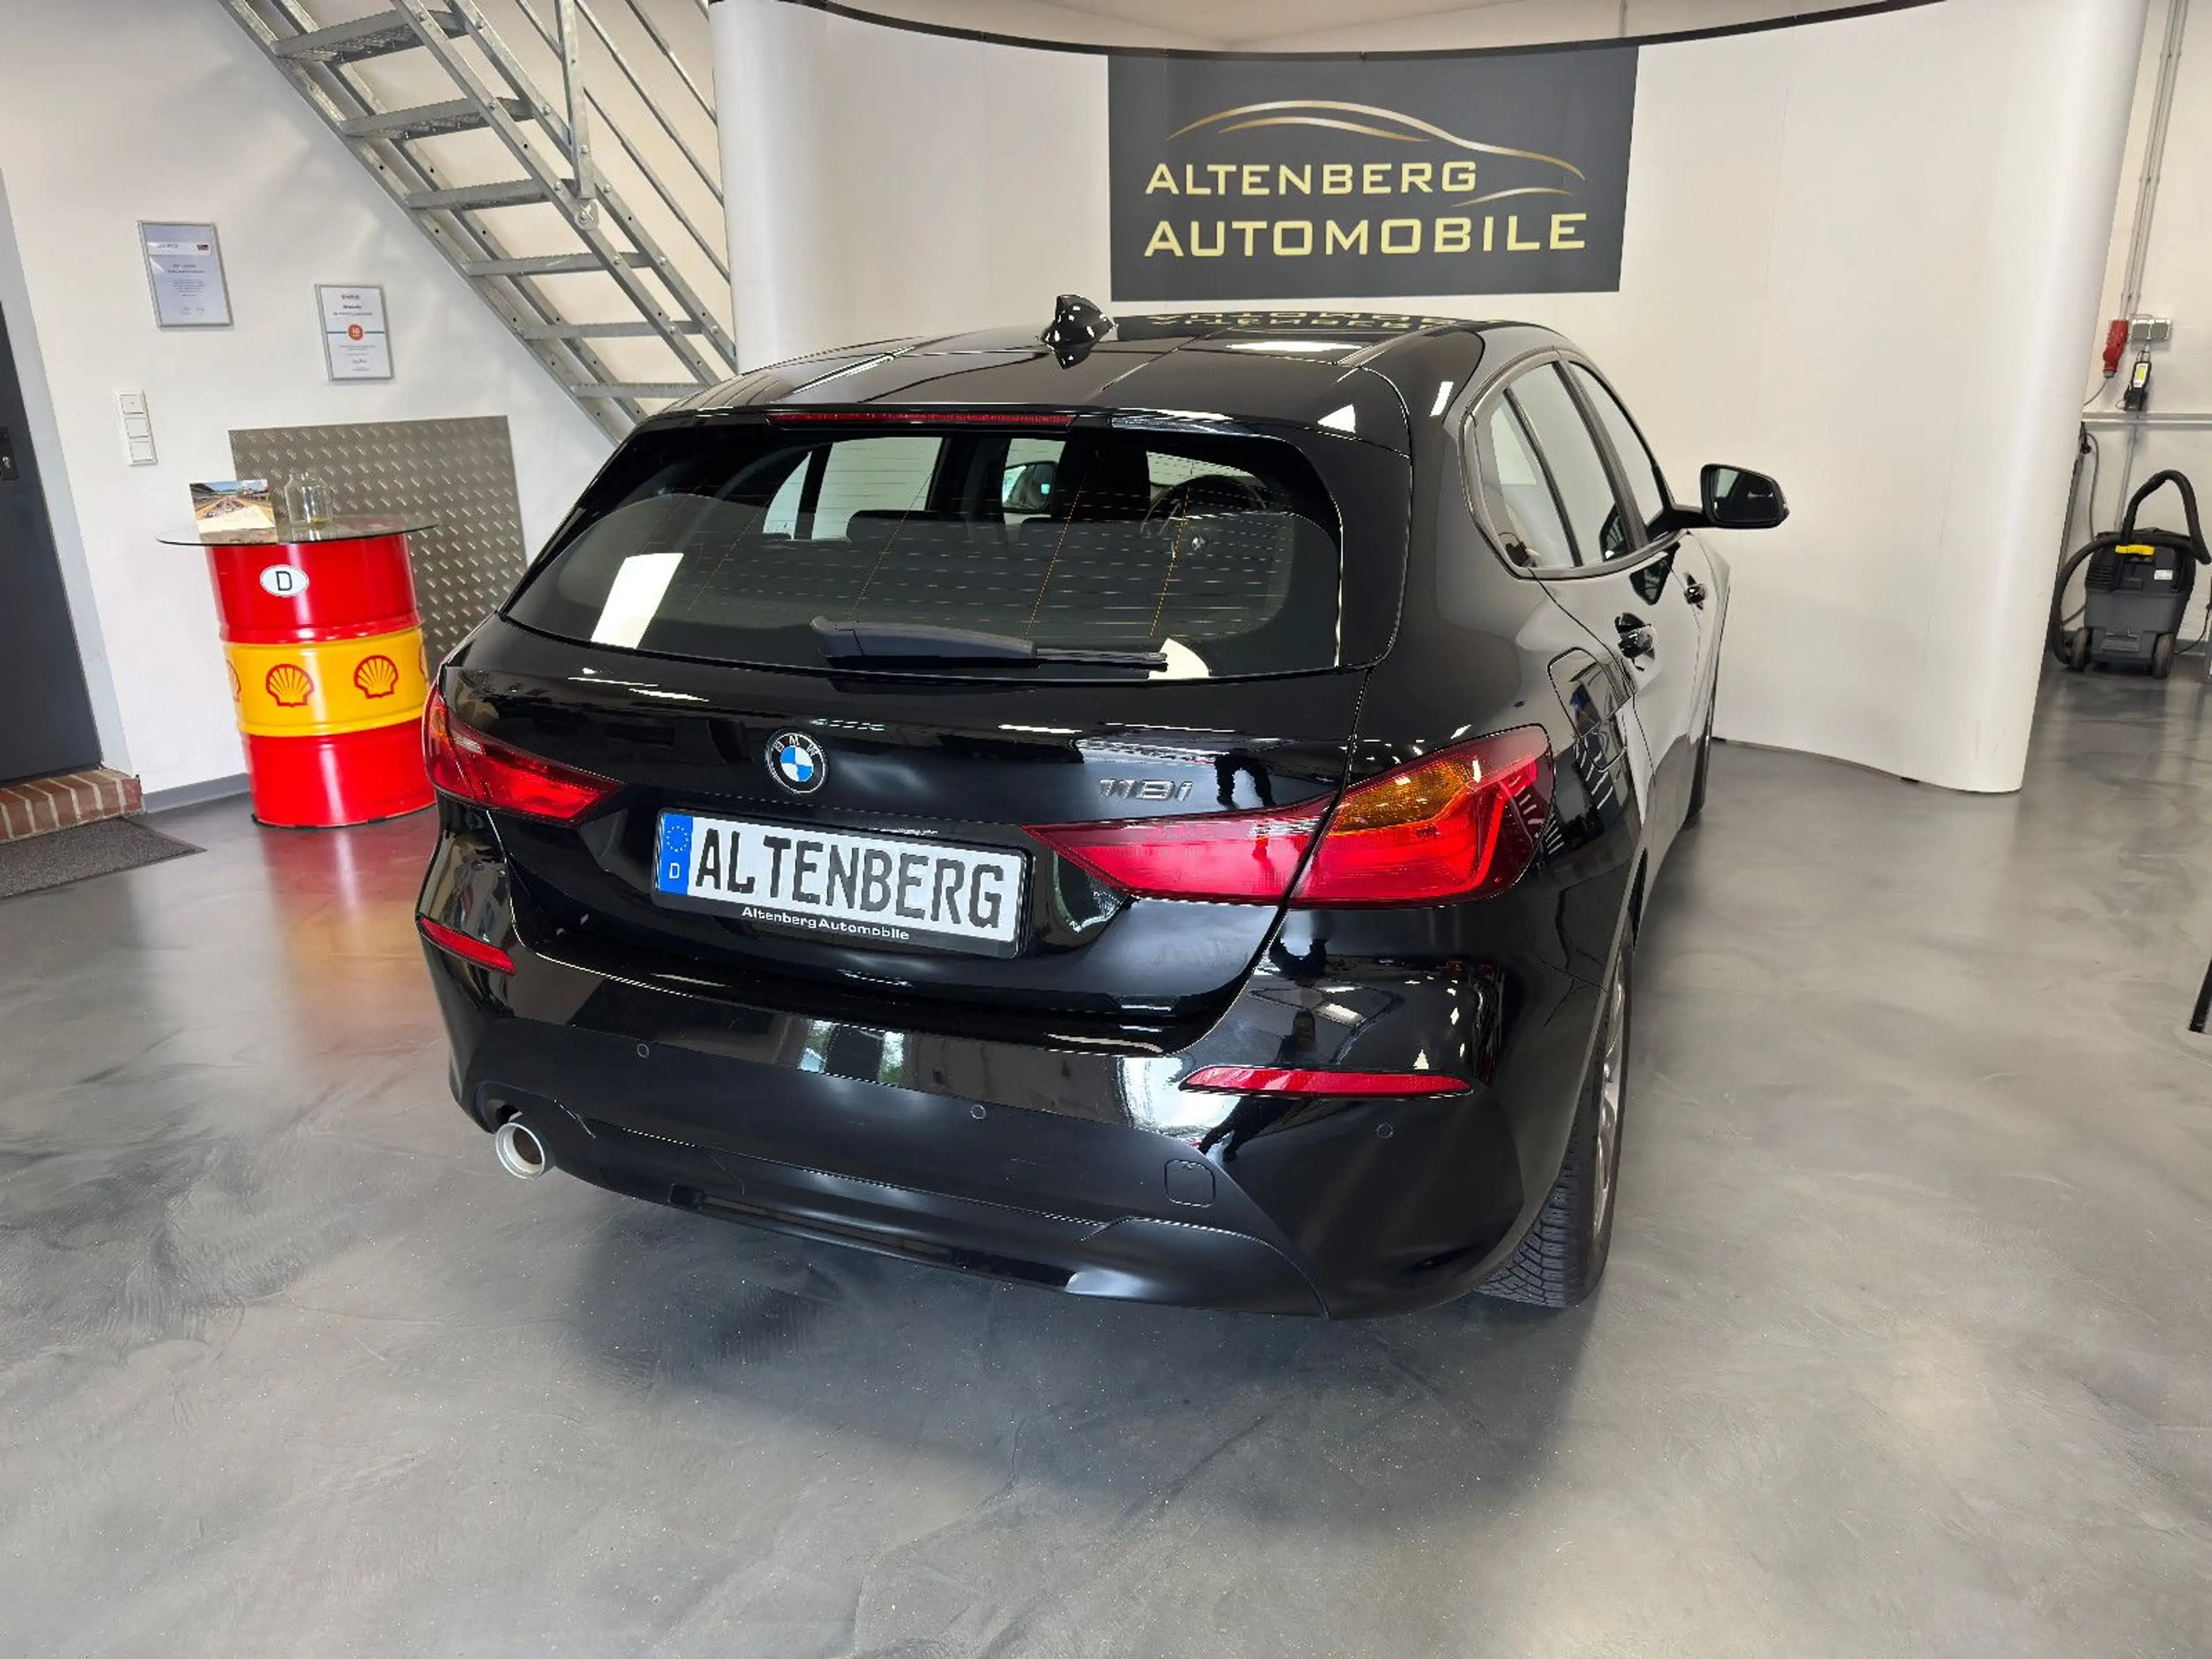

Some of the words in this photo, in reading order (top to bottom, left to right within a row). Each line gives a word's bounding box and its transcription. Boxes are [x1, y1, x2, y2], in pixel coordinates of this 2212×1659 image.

[1145, 161, 1477, 195] ALTENBERG
[1143, 212, 1587, 257] AUTOMOBILE
[275, 571, 293, 591] D
[772, 735, 819, 757] BMW
[669, 862, 680, 878] D
[695, 828, 1004, 929] ALTENBERG
[741, 906, 817, 929] Altenberg
[818, 918, 910, 940] Automobile
